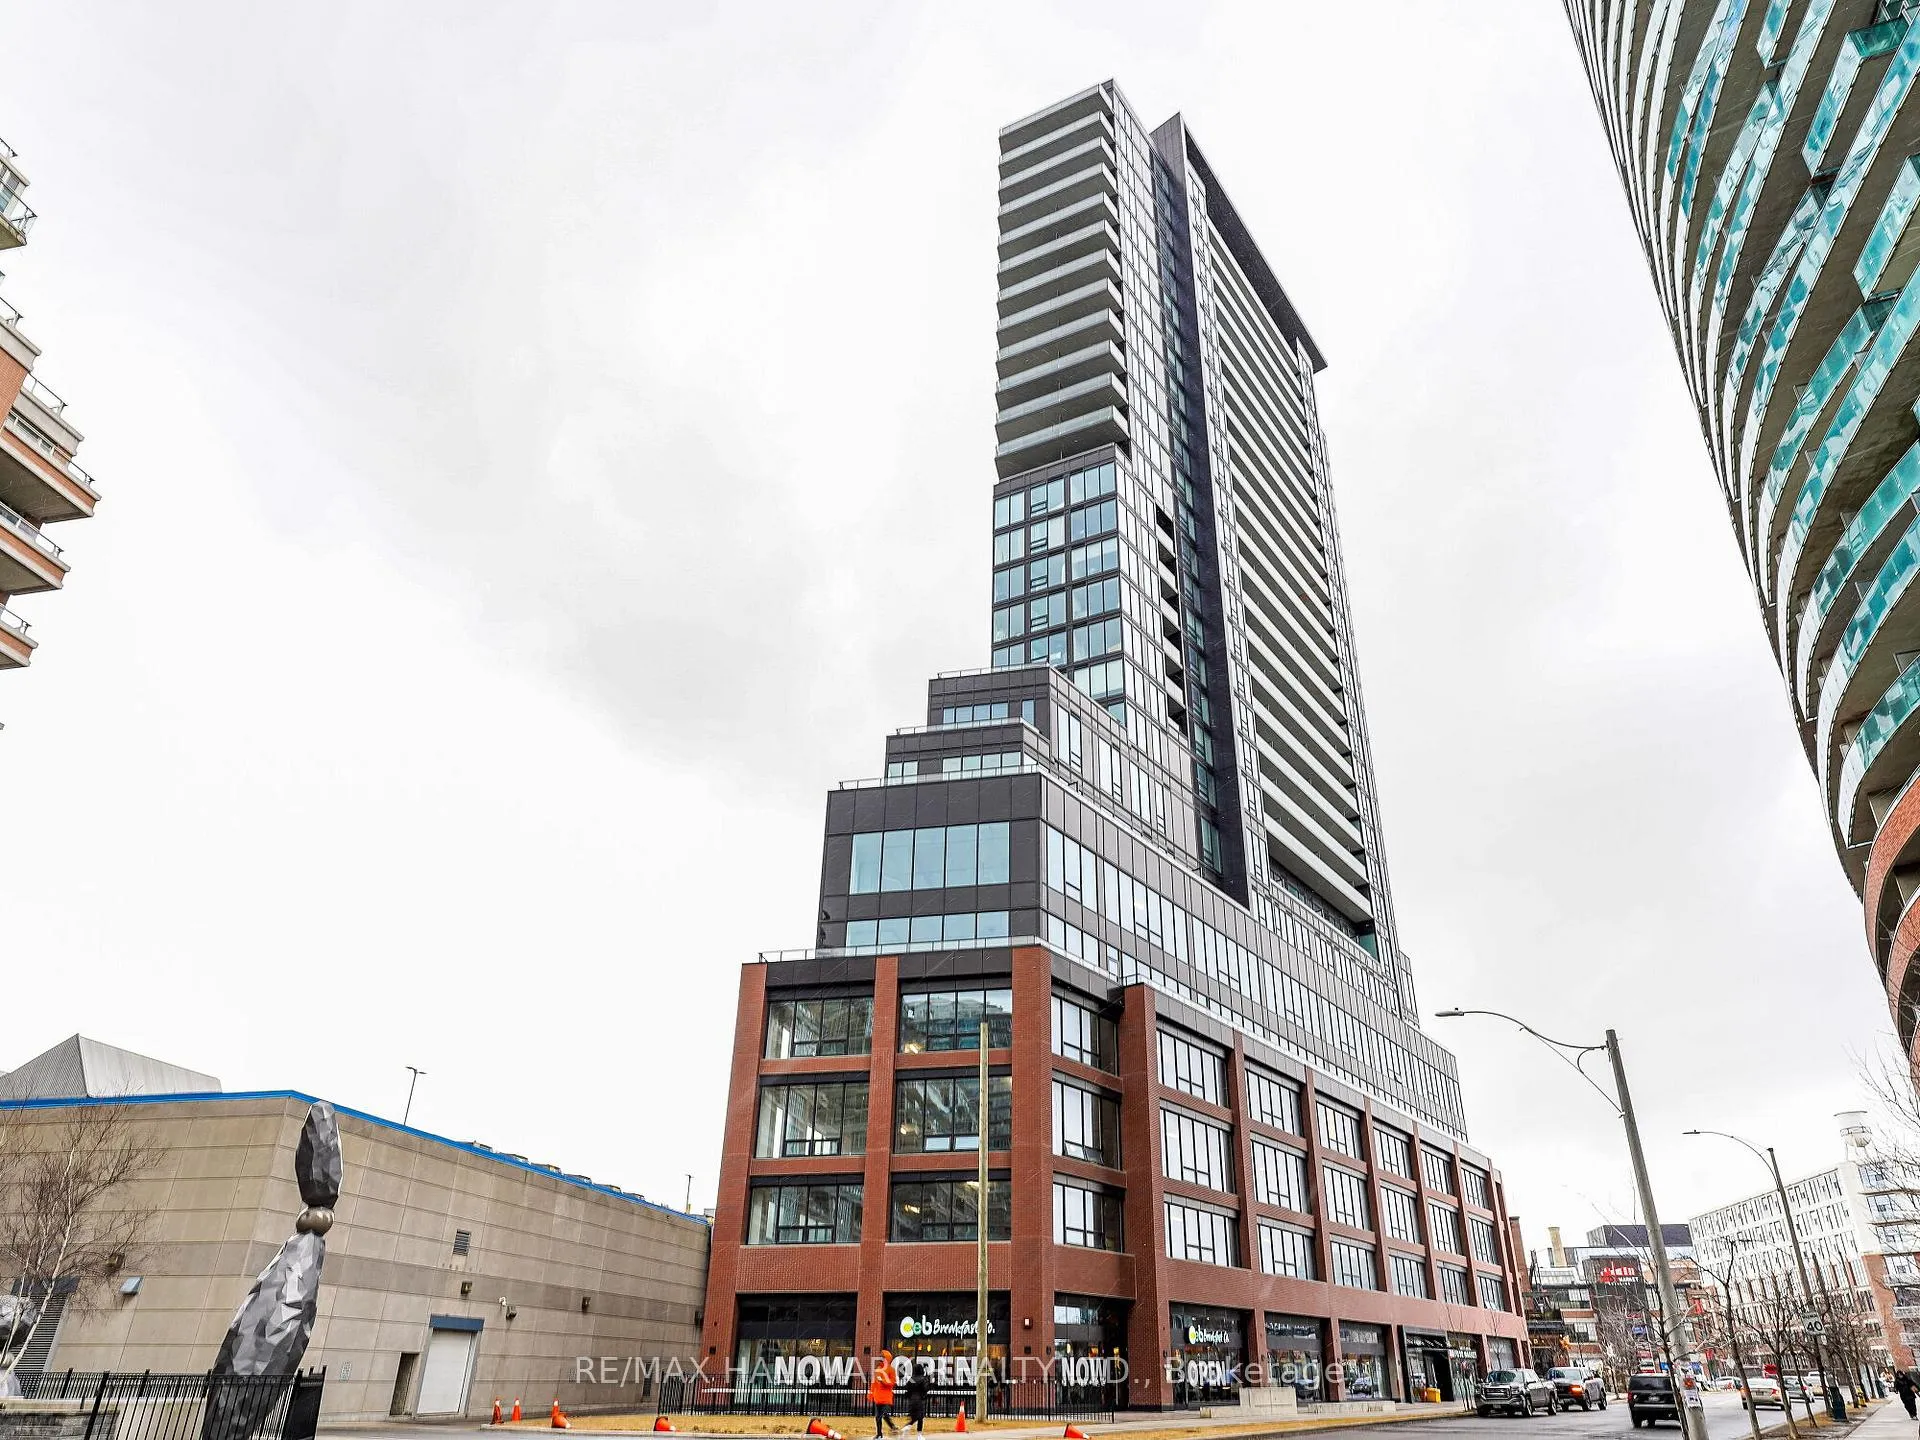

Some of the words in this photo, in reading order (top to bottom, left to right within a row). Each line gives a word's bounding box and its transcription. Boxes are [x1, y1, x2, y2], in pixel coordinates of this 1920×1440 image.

[933, 1318, 978, 1340] Breakfast
[1807, 1321, 1822, 1331] 40
[774, 1355, 854, 1386] NOW
[890, 1356, 977, 1387] OPEN
[1061, 1356, 1107, 1387] NOW
[1187, 1359, 1227, 1388] OPEN
